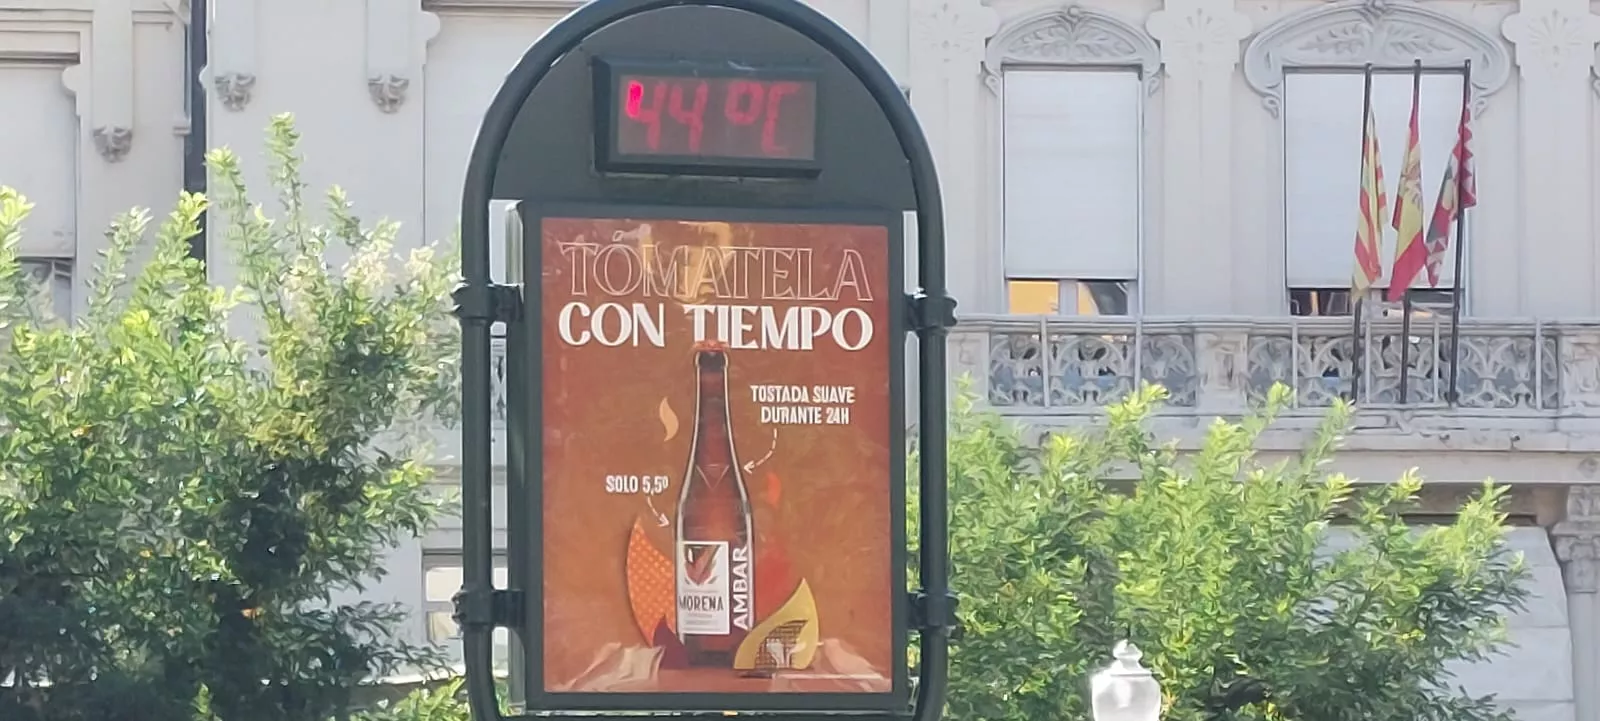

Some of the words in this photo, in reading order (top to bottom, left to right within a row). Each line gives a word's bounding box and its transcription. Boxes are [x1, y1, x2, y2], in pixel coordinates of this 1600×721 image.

[626, 80, 708, 153] 44
[558, 230, 874, 301] TÓMATELA
[558, 302, 665, 346] CON
[684, 304, 874, 350] TIEMPO
[750, 385, 809, 402] TOSTADA
[812, 386, 855, 403] SUAVE
[761, 406, 822, 424] DURANTE
[826, 408, 849, 424] 24H
[605, 475, 639, 493] SOLO
[679, 595, 724, 611] MORENA
[732, 545, 748, 630] AMBAR
